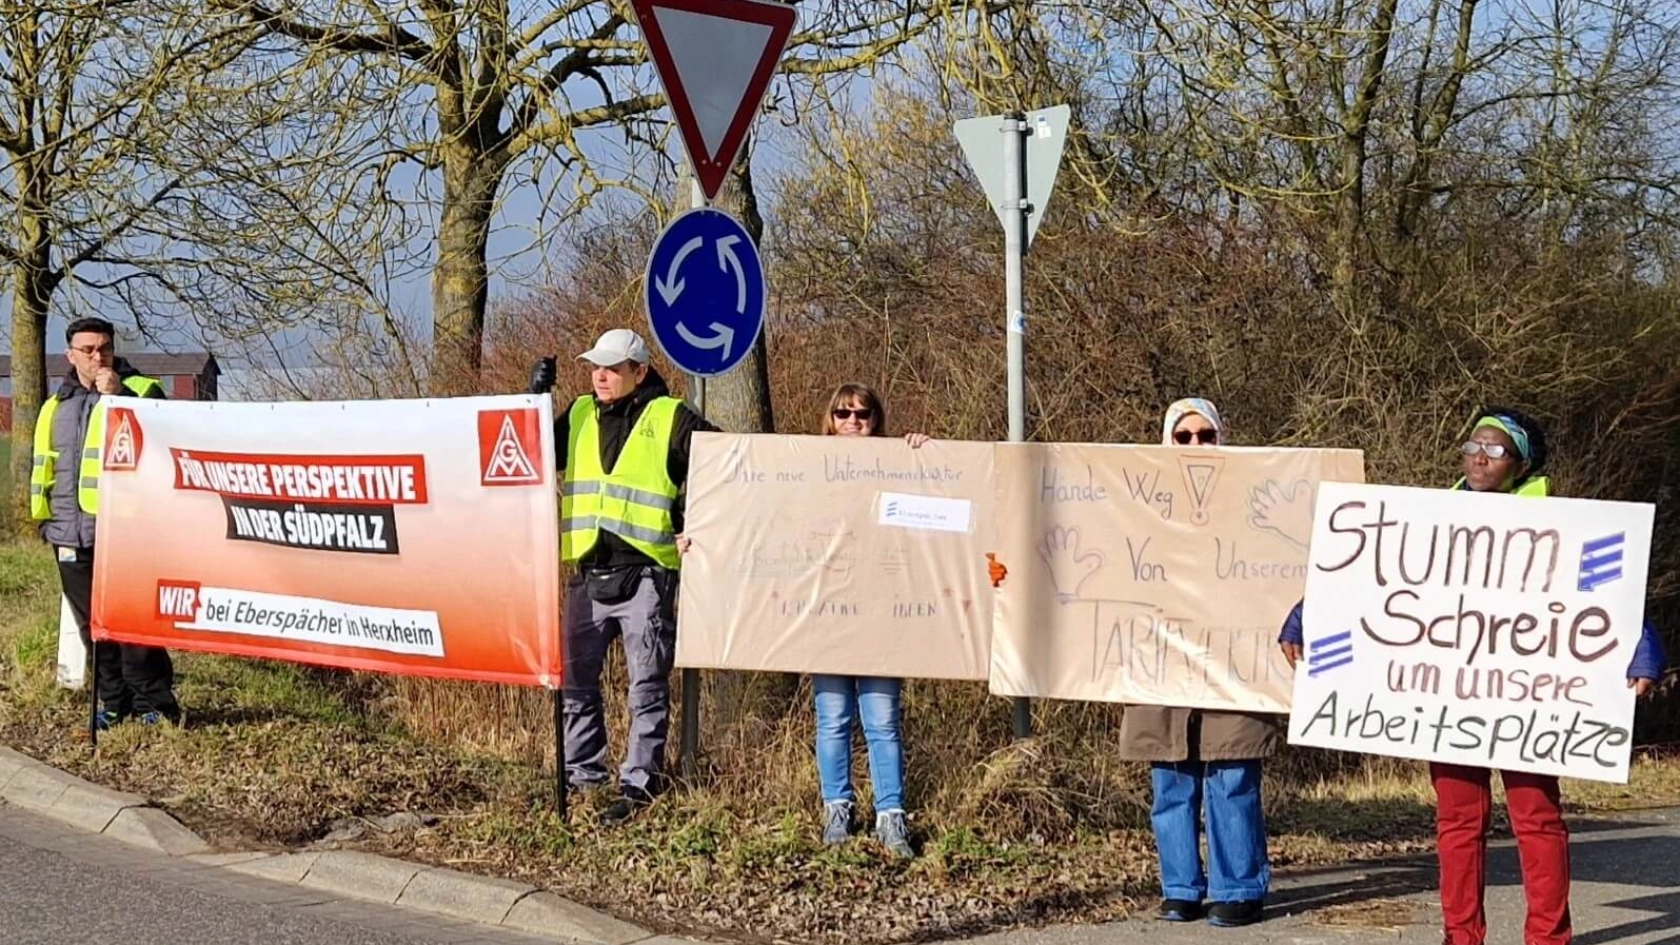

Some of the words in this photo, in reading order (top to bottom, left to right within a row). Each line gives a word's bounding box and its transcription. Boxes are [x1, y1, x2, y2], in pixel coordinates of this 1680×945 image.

[178, 451, 206, 489] FÜR
[203, 460, 274, 496] UNSERE
[270, 464, 417, 501] PERSPEKTIVE
[230, 505, 251, 537] IN
[249, 508, 287, 542] DER
[284, 503, 387, 550] SÜDPFALZ
[1315, 500, 1560, 592] Stumm
[1126, 536, 1168, 583] Von
[158, 585, 196, 617] WIR
[206, 597, 232, 622] bei
[234, 601, 343, 634] Eberspächer
[346, 613, 360, 637] in
[361, 616, 435, 647] Herxheim
[1360, 589, 1619, 665] Schreie
[1386, 658, 1441, 696] um
[1454, 666, 1593, 707] unsere
